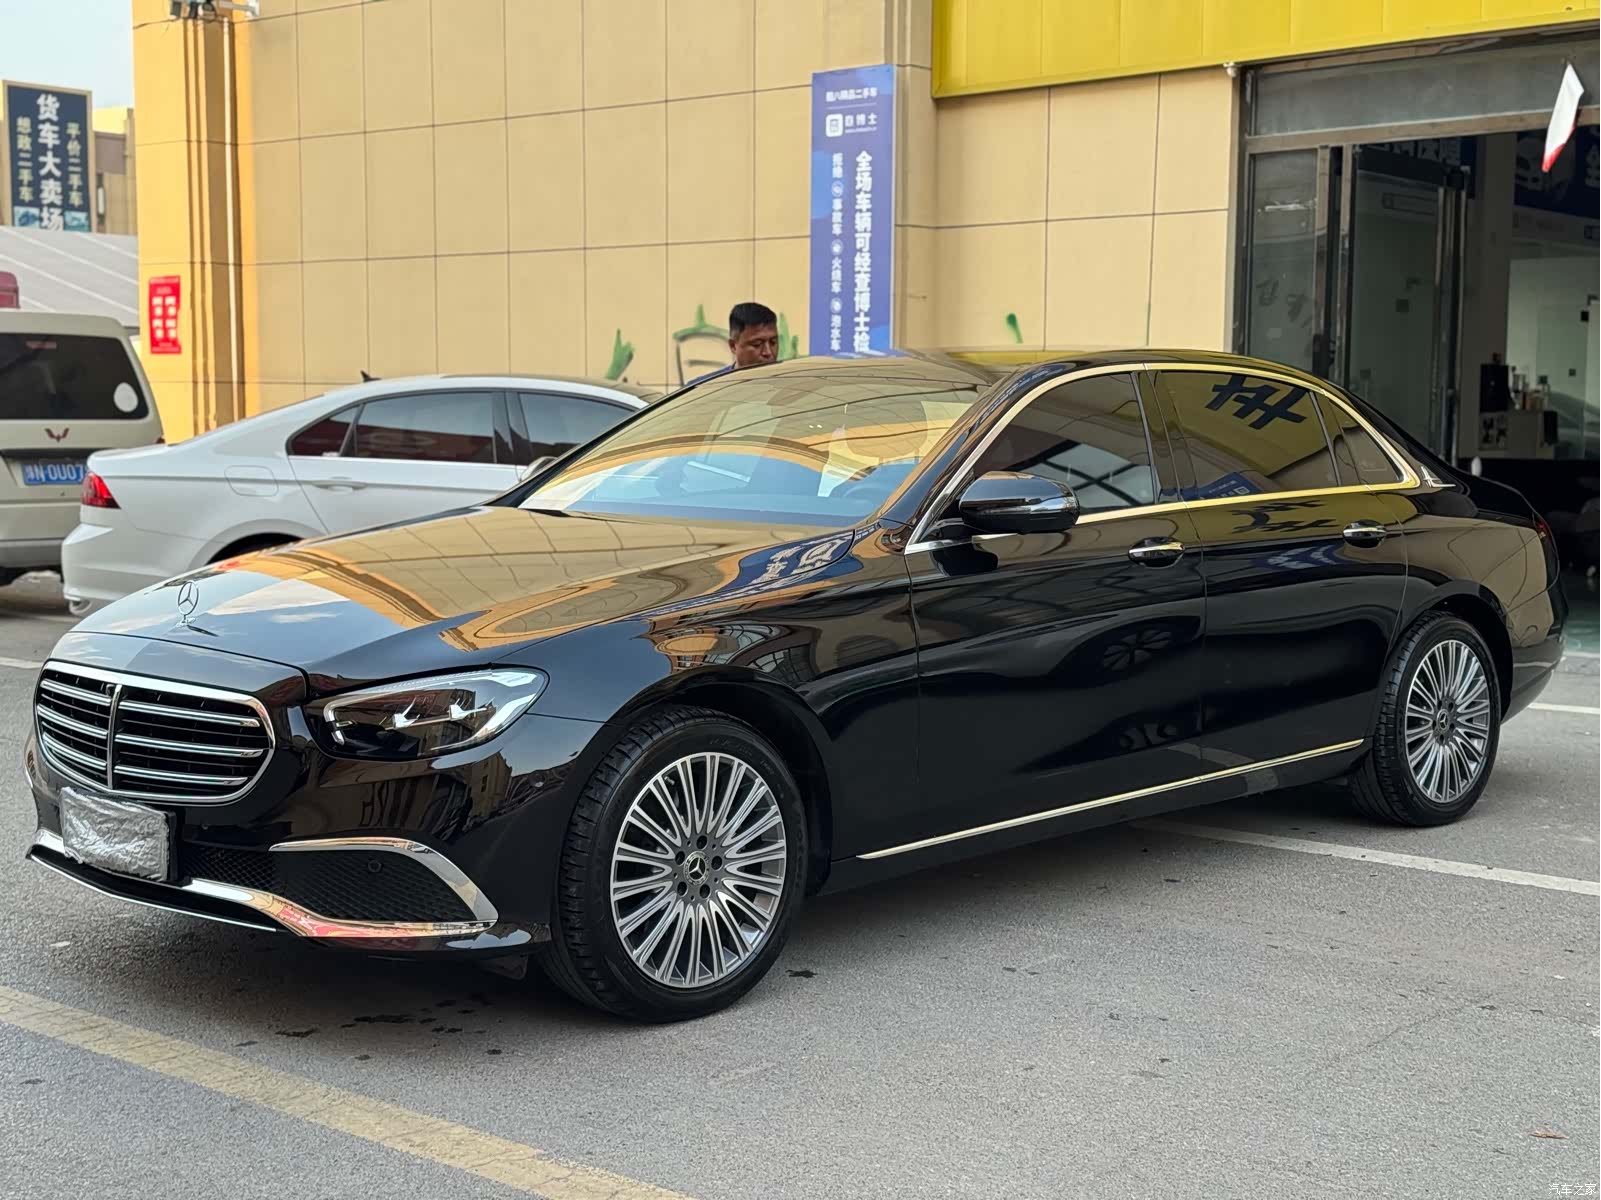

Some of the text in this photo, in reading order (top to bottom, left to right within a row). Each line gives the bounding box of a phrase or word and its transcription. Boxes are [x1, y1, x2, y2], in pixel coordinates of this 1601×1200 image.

[36, 93, 64, 231] 货车大卖场
